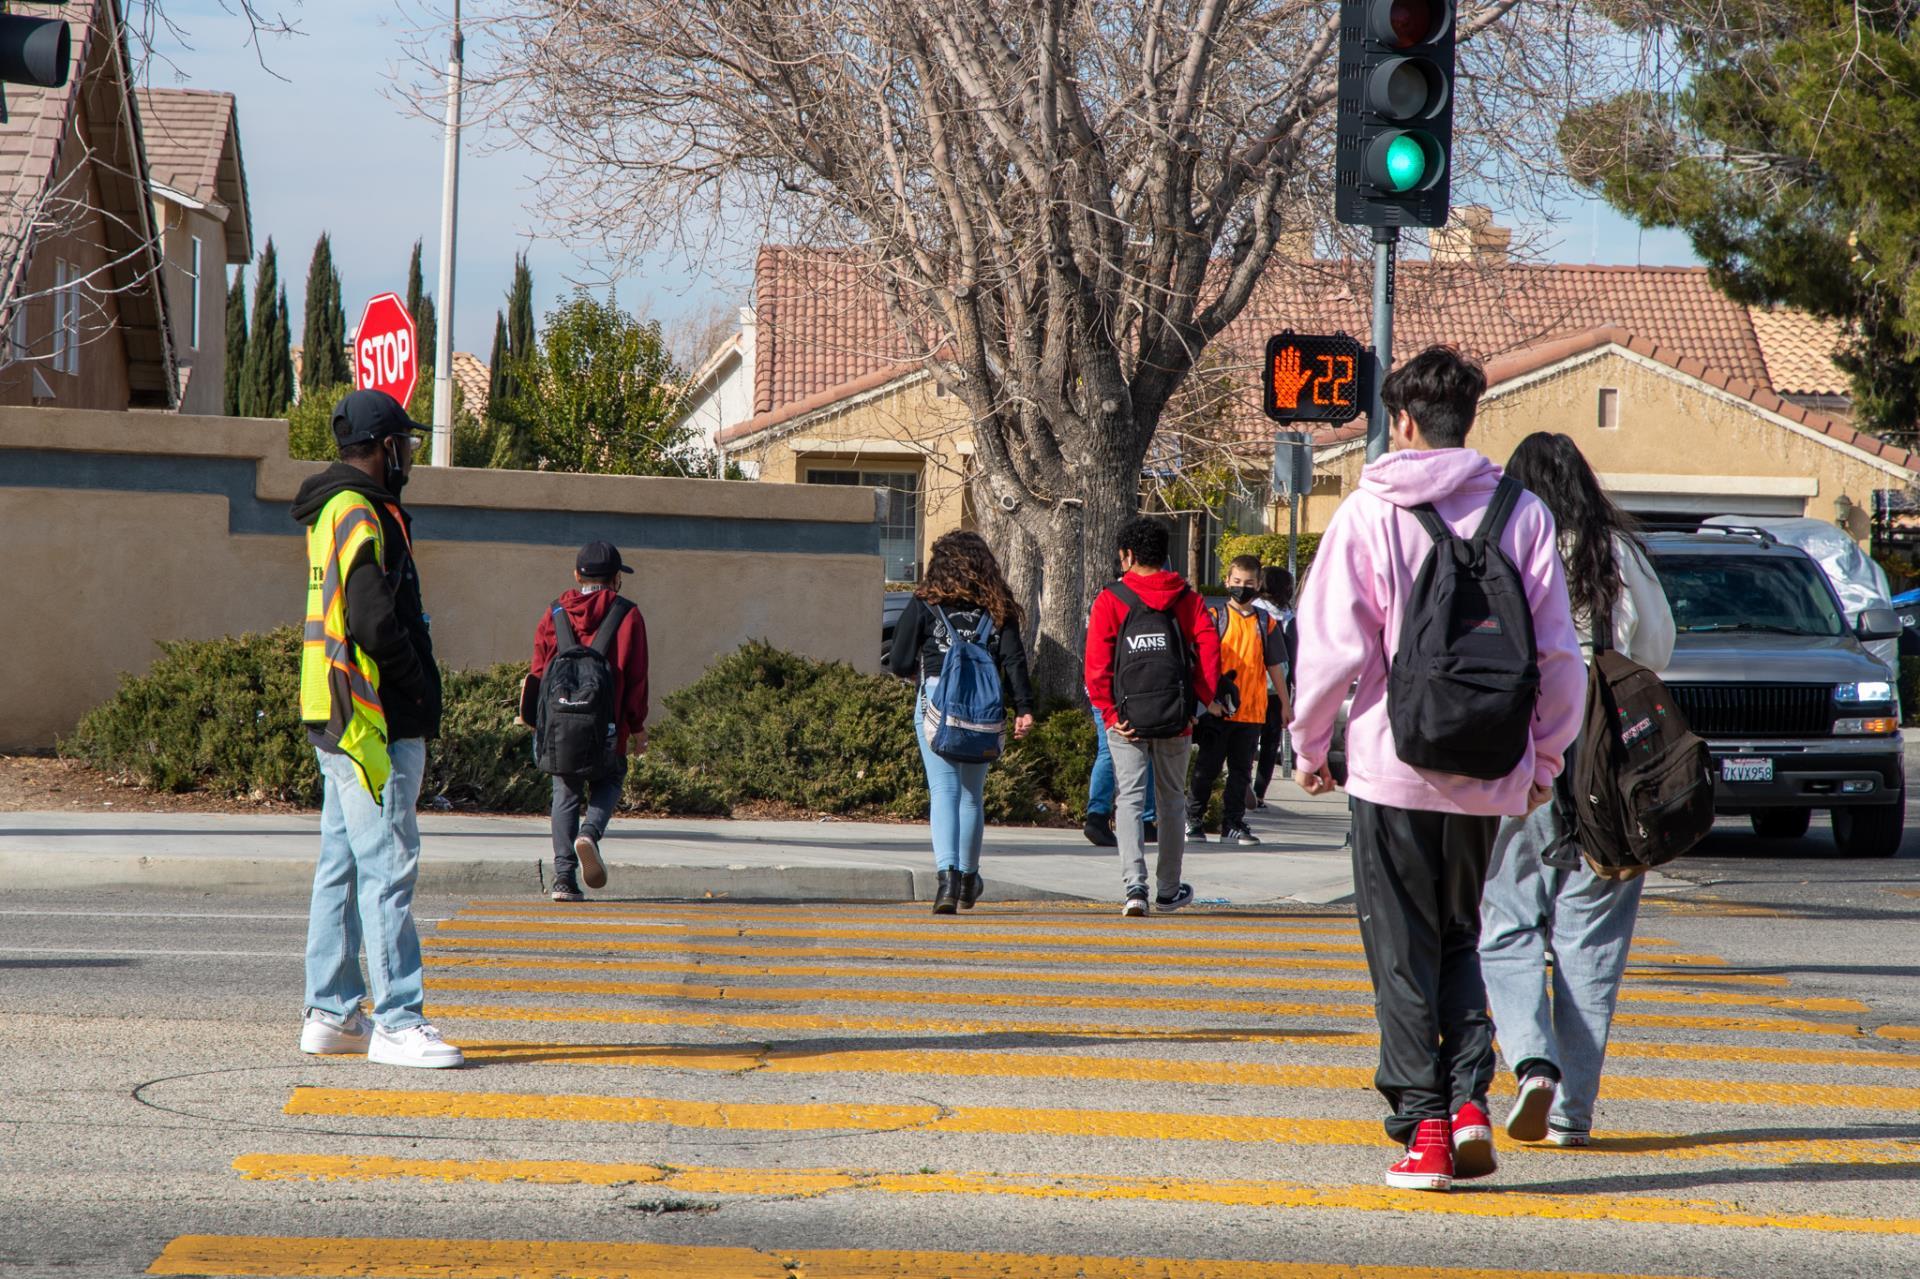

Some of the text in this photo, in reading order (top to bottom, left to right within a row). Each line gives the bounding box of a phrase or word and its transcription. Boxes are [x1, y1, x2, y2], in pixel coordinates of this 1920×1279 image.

[361, 328, 410, 390] STOP
[1313, 355, 1353, 406] 22
[1126, 633, 1166, 650] VANS
[1723, 766, 1772, 780] 7KVX958
